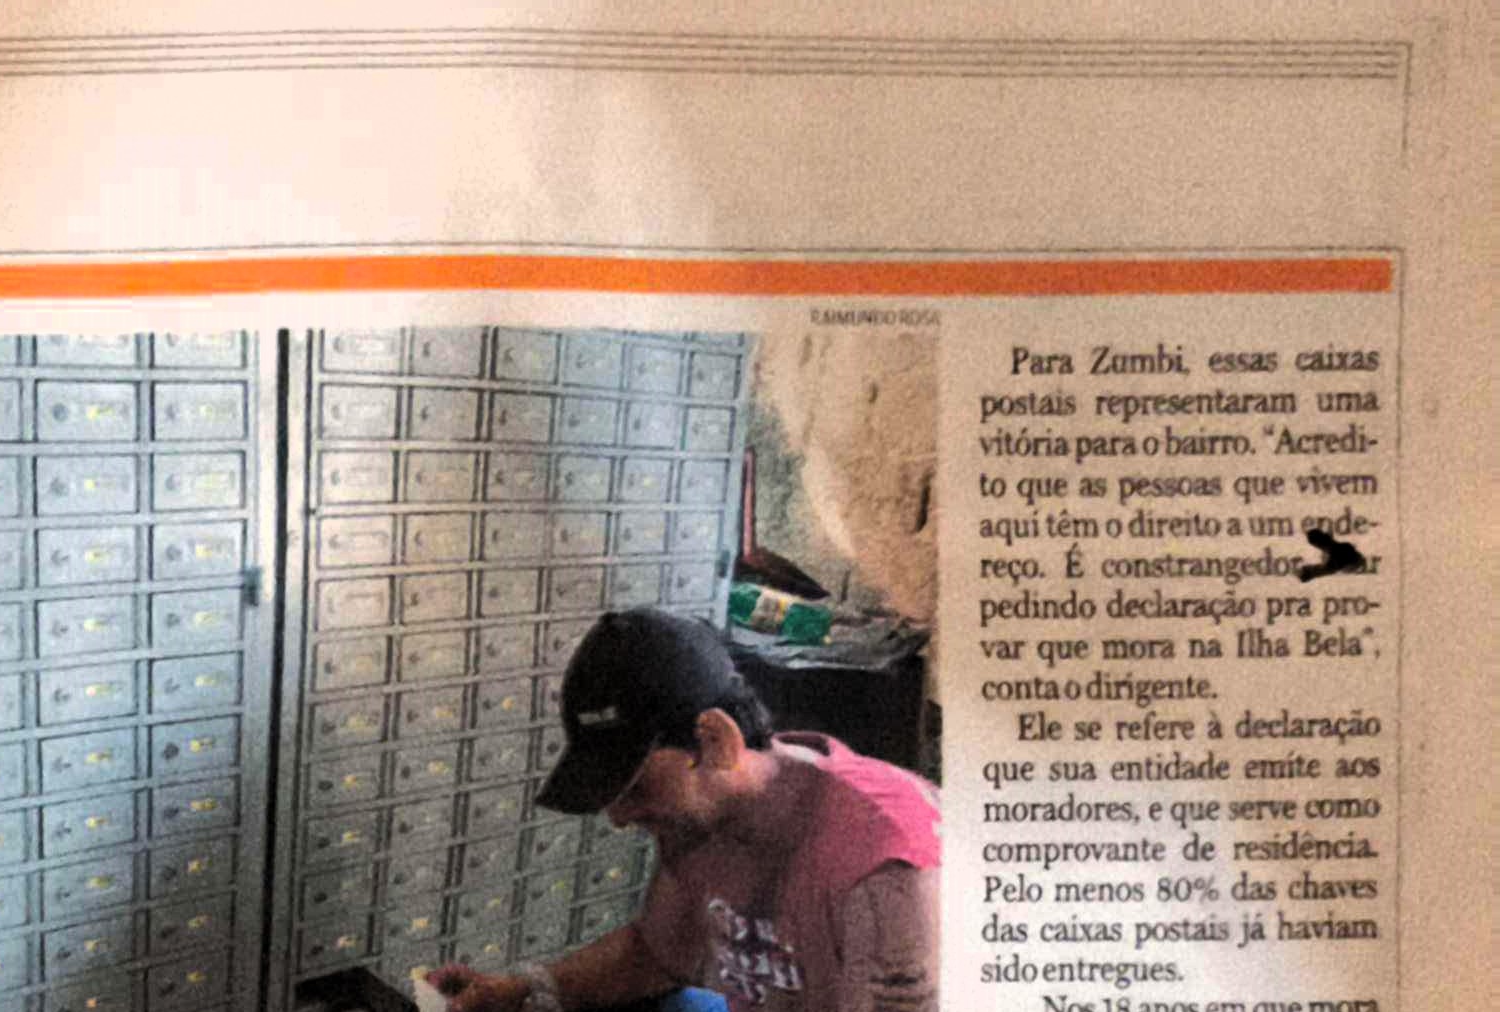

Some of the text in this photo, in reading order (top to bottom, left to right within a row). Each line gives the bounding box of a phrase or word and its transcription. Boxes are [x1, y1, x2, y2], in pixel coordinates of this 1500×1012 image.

[1017, 708, 1382, 746] Ele se refere à declaração
[983, 870, 1378, 904] Pelo menos 80% das chaves
